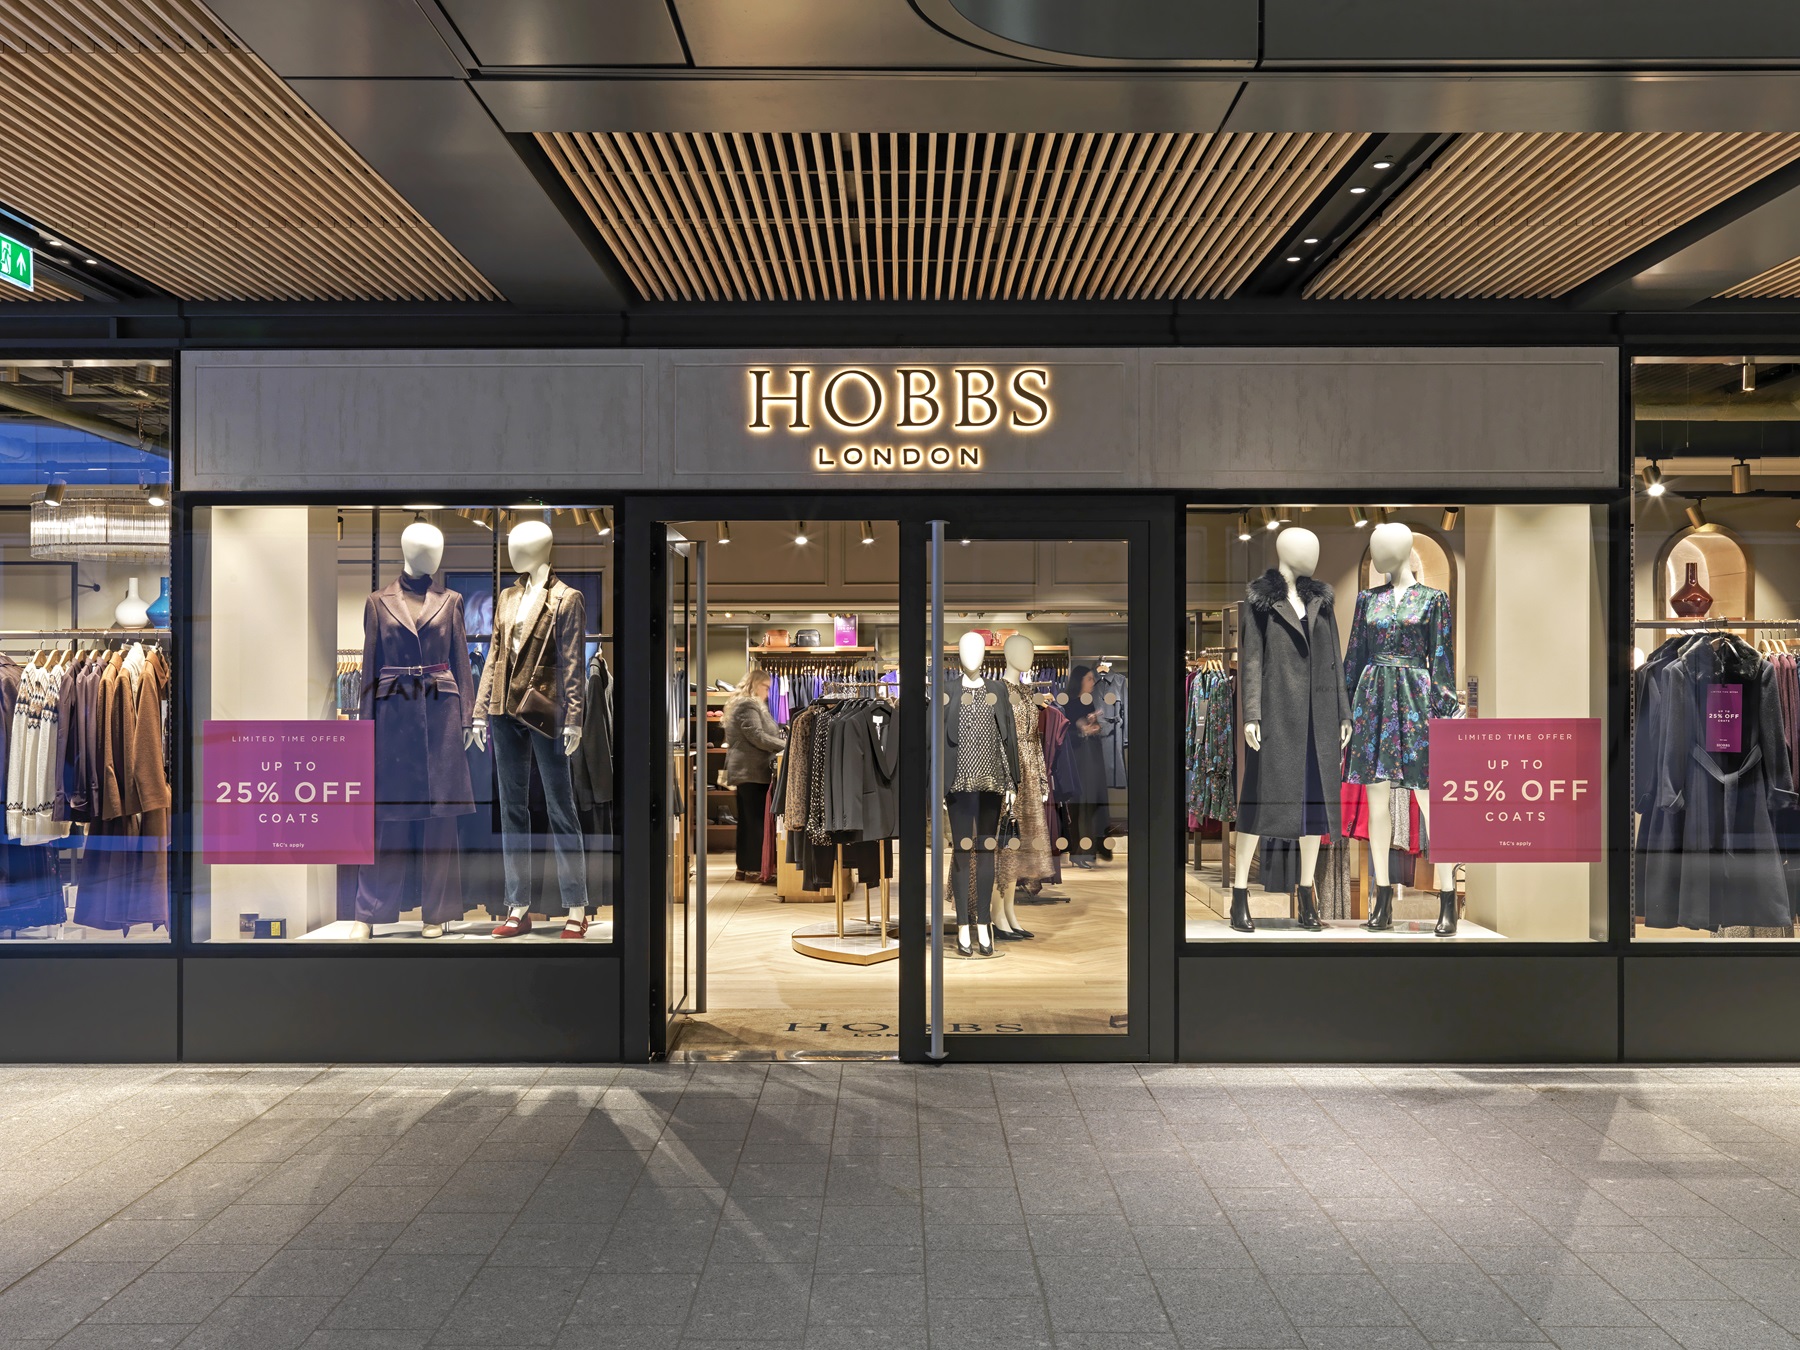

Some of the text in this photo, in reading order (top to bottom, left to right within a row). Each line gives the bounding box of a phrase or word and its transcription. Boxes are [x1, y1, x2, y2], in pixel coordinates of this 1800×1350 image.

[748, 369, 1048, 428] HOBBS
[818, 447, 979, 465] LONDON
[231, 735, 346, 743] LIMITED TIME OFFER
[1458, 733, 1573, 741] LIMITED TIME OFFER
[261, 761, 317, 772] UP TO
[1487, 759, 1543, 770] UP TO
[216, 781, 362, 804] 25% OFF
[1442, 779, 1588, 802] 25% OFF
[258, 813, 320, 824] COATS
[1485, 811, 1546, 822] COATS
[785, 1022, 1024, 1033] HOBS
